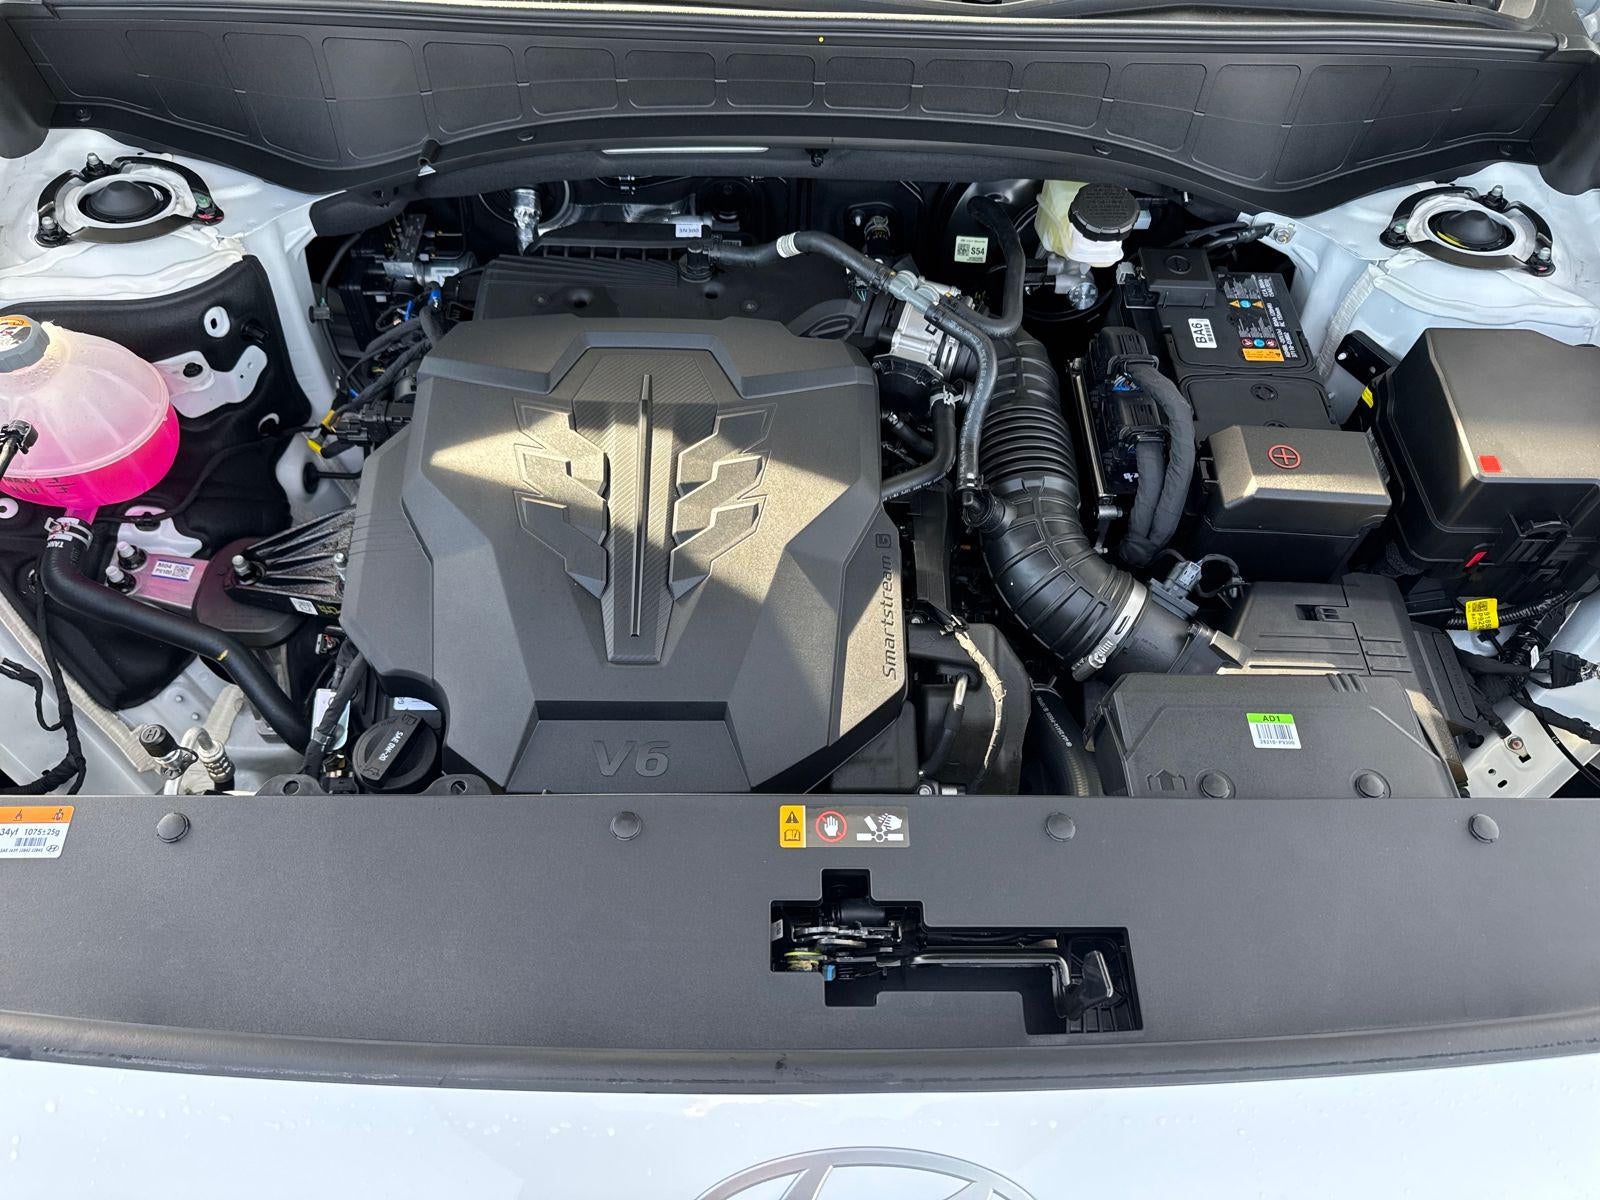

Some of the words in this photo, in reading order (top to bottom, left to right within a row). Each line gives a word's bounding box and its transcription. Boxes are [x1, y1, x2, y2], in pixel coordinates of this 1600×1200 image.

[970, 246, 985, 255] S54
[1191, 322, 1208, 344] BA6
[880, 556, 897, 681] Smartstream
[391, 730, 404, 743] SAE
[378, 742, 396, 761] 0W-20
[592, 740, 671, 777] V6
[24, 828, 60, 837] 1075±25g
